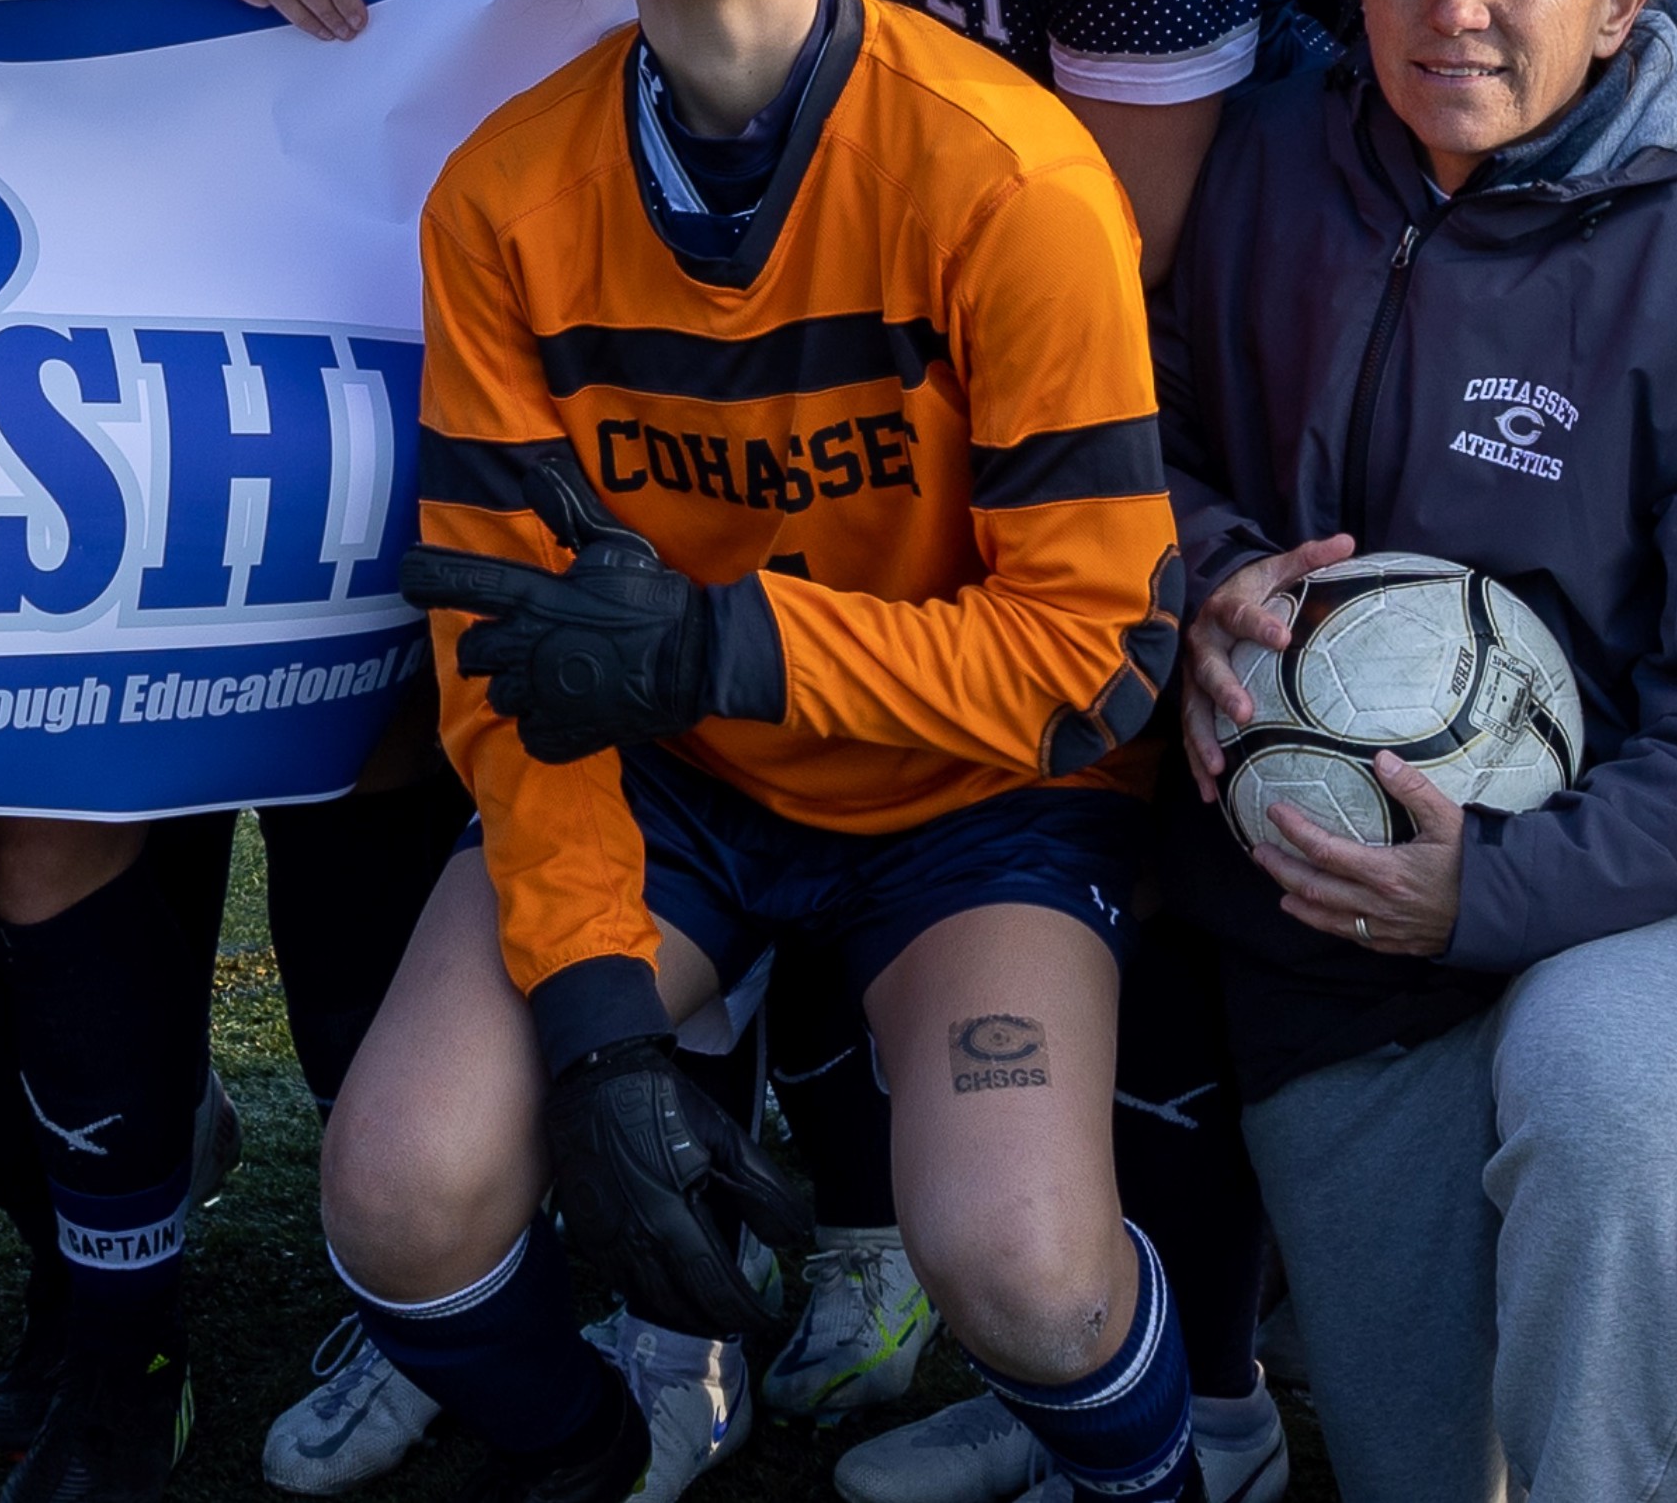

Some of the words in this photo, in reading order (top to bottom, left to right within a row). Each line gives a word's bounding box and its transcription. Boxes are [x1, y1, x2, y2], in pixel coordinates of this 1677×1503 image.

[1464, 378, 1579, 431] COHASSET
[1449, 430, 1563, 480] ATHLETICS
[120, 646, 399, 723] Educational
[954, 1068, 1046, 1093] CHSGS
[67, 1220, 176, 1261] CAPTAIN
